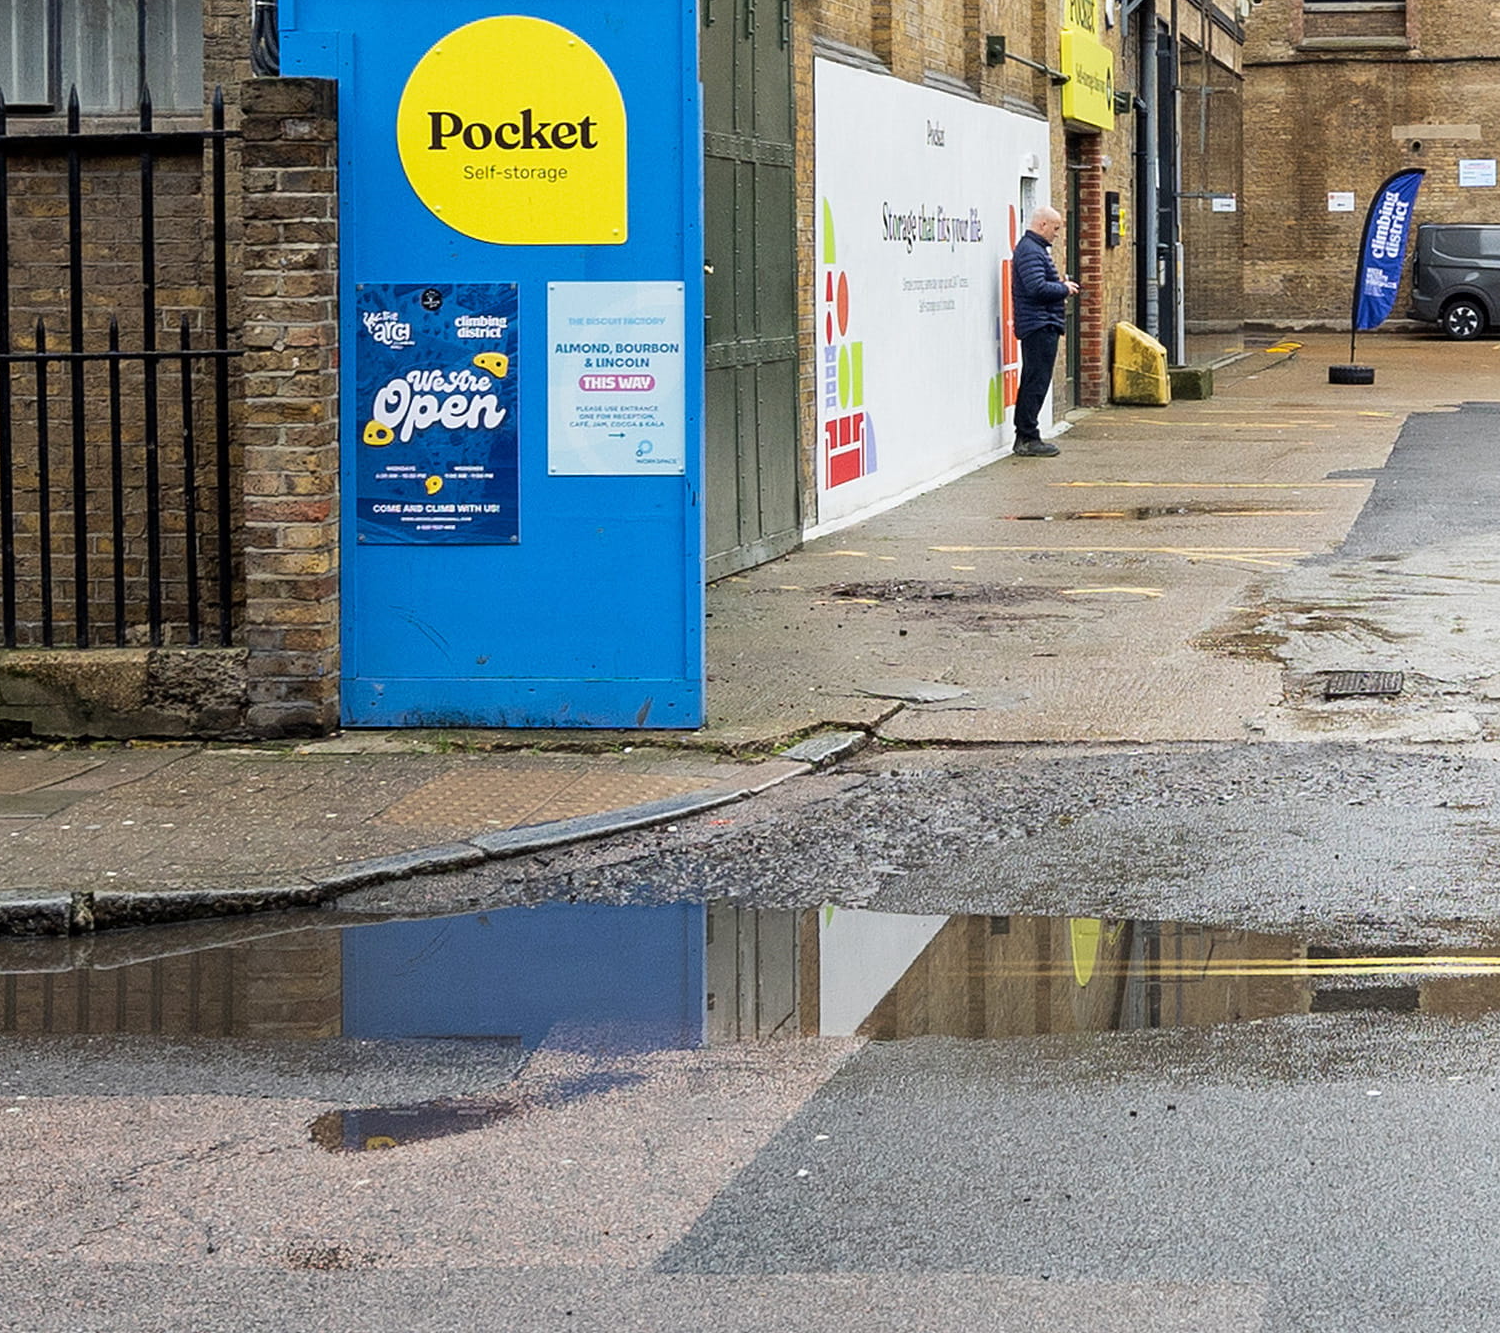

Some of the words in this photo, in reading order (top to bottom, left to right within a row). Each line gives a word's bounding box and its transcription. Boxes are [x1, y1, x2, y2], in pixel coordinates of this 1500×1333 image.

[427, 108, 599, 151] Pocket
[463, 164, 569, 183] Self-storage
[882, 201, 917, 254] Storage
[918, 203, 935, 242] that
[1371, 191, 1400, 259] climbing
[1385, 201, 1410, 259] district
[454, 315, 508, 328] climbing
[568, 317, 584, 326] THE
[586, 317, 622, 326] BISCUIT
[623, 317, 666, 326] FACTORY
[457, 326, 503, 339] district
[555, 343, 613, 355] ALMOND,
[615, 343, 680, 354] BOURBON
[584, 357, 593, 368] &
[596, 357, 650, 368] LINCOLN
[406, 369, 446, 392] We
[443, 369, 492, 393] Are
[582, 376, 616, 390] THIS
[617, 376, 652, 390] WAY
[373, 378, 507, 443] Open
[372, 504, 402, 513] COME
[403, 504, 424, 513] AND
[425, 504, 456, 513] CLIMB
[457, 504, 482, 513] WITH
